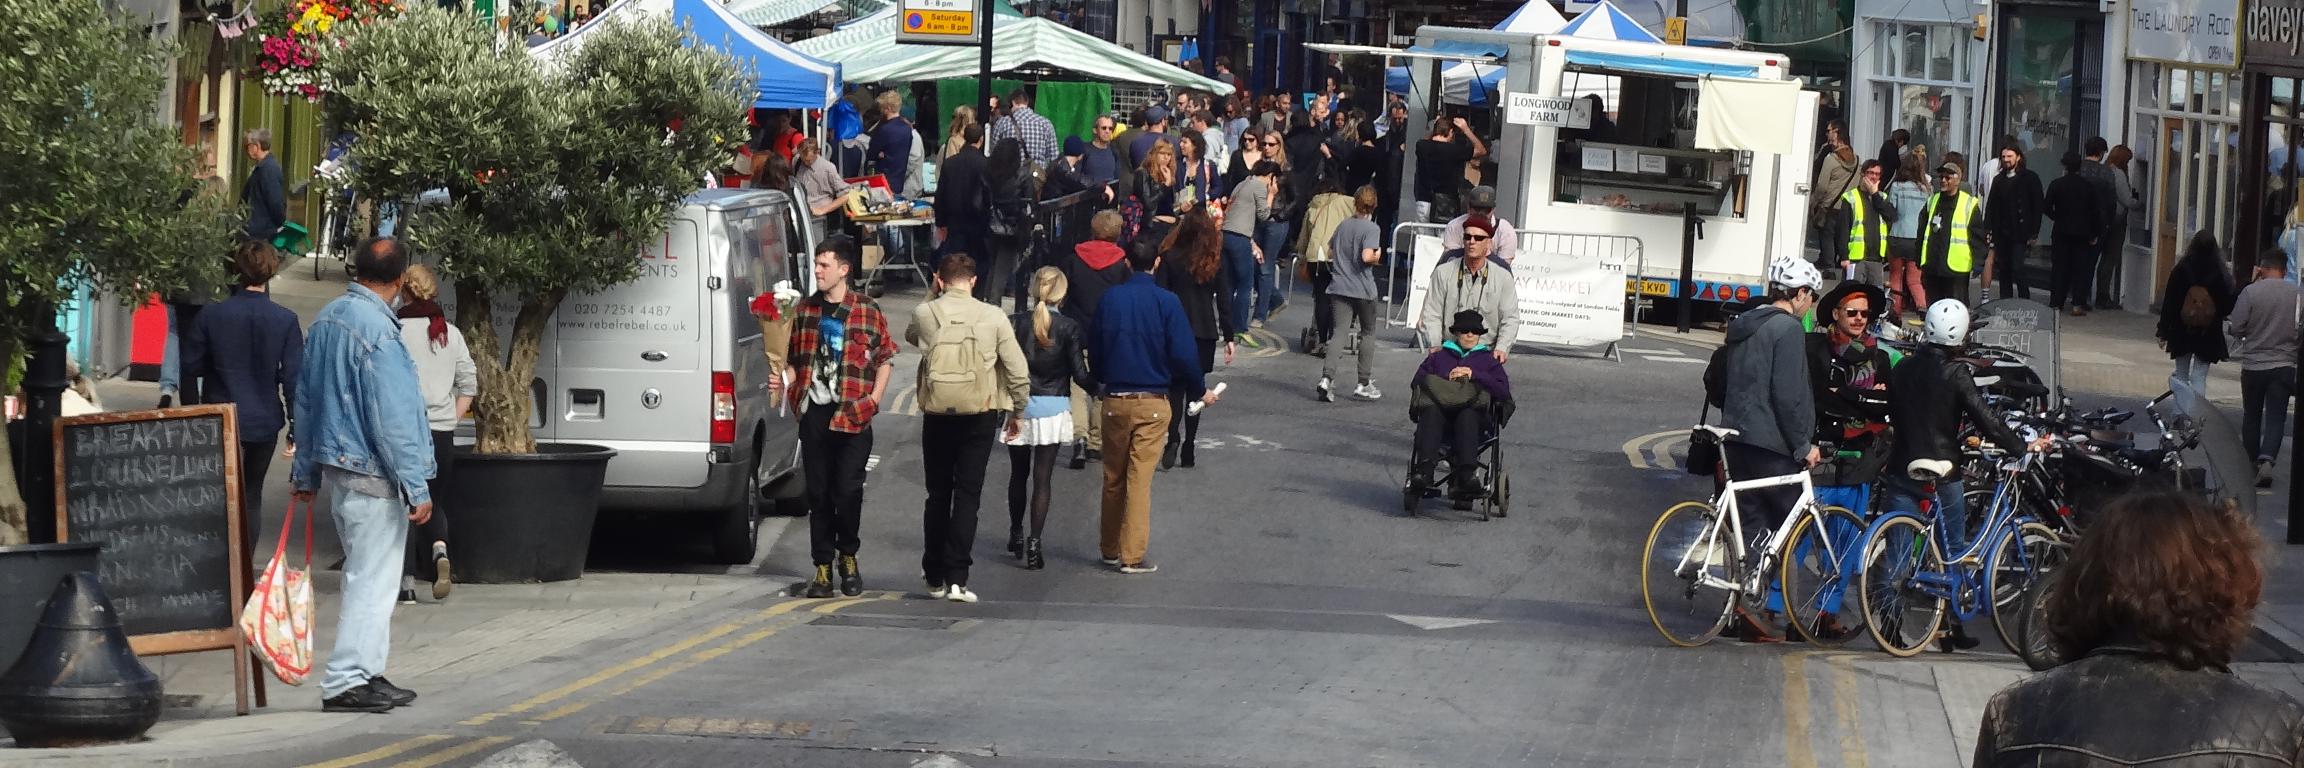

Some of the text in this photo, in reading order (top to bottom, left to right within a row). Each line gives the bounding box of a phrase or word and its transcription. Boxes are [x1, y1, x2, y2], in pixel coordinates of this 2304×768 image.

[930, 13, 966, 22] Saturday
[2132, 8, 2151, 30] THE
[2154, 9, 2200, 34] LAUNDRY
[2248, 0, 2304, 56] davey
[1514, 97, 1572, 111] LONGWOOD
[1529, 110, 1560, 123] FARM
[1535, 278, 1591, 295] MARKET
[574, 304, 671, 316] 020 7254 4487
[559, 319, 686, 331] www.rebelrebel.co.uk
[1998, 333, 2031, 352] FISH
[74, 419, 219, 457] BREAKFAST
